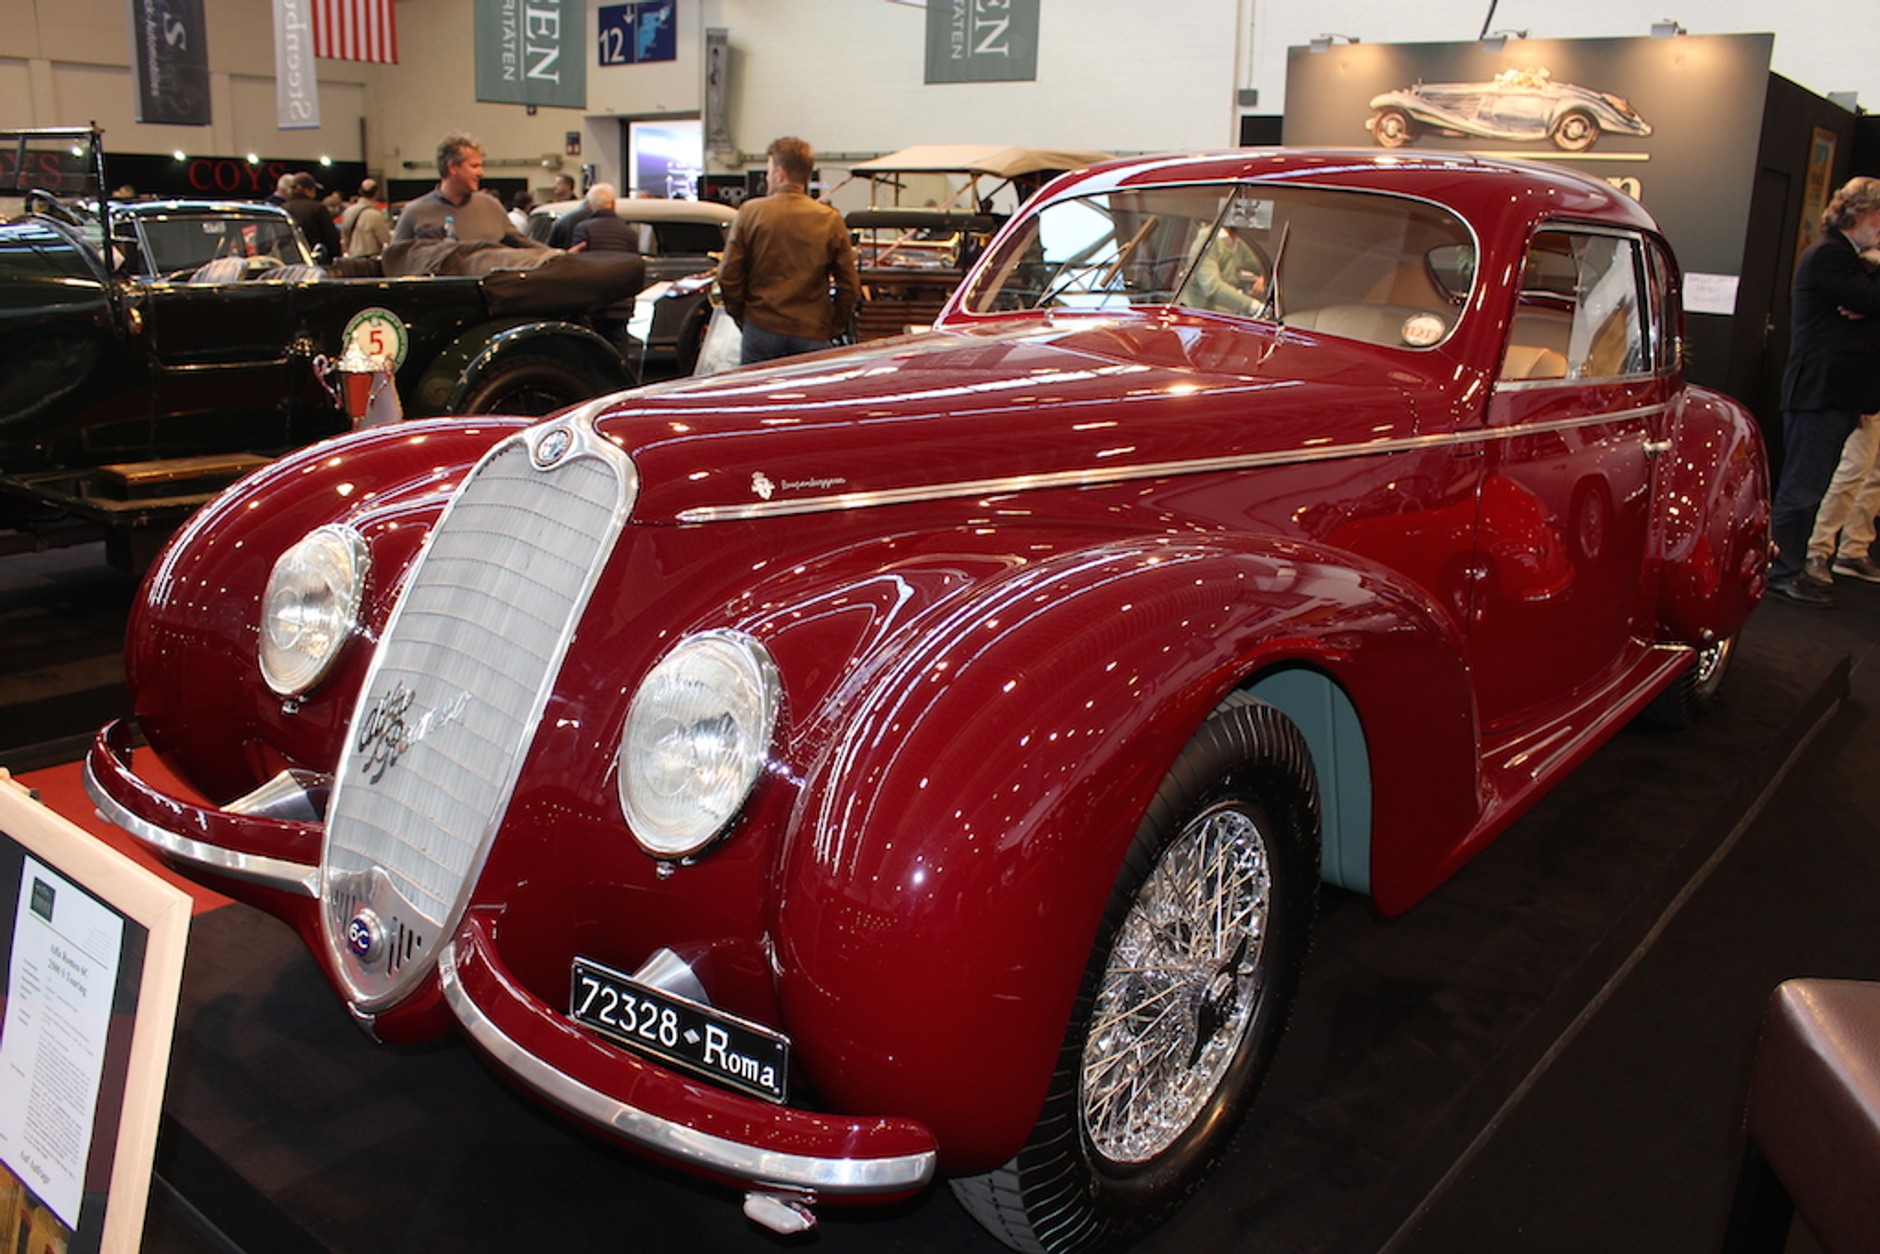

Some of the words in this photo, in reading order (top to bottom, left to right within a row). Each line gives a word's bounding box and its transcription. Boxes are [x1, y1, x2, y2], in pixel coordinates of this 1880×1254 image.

[600, 27, 625, 63] 12
[369, 329, 384, 356] 5
[581, 976, 679, 1048] 72328
[702, 1023, 776, 1089] Roma
